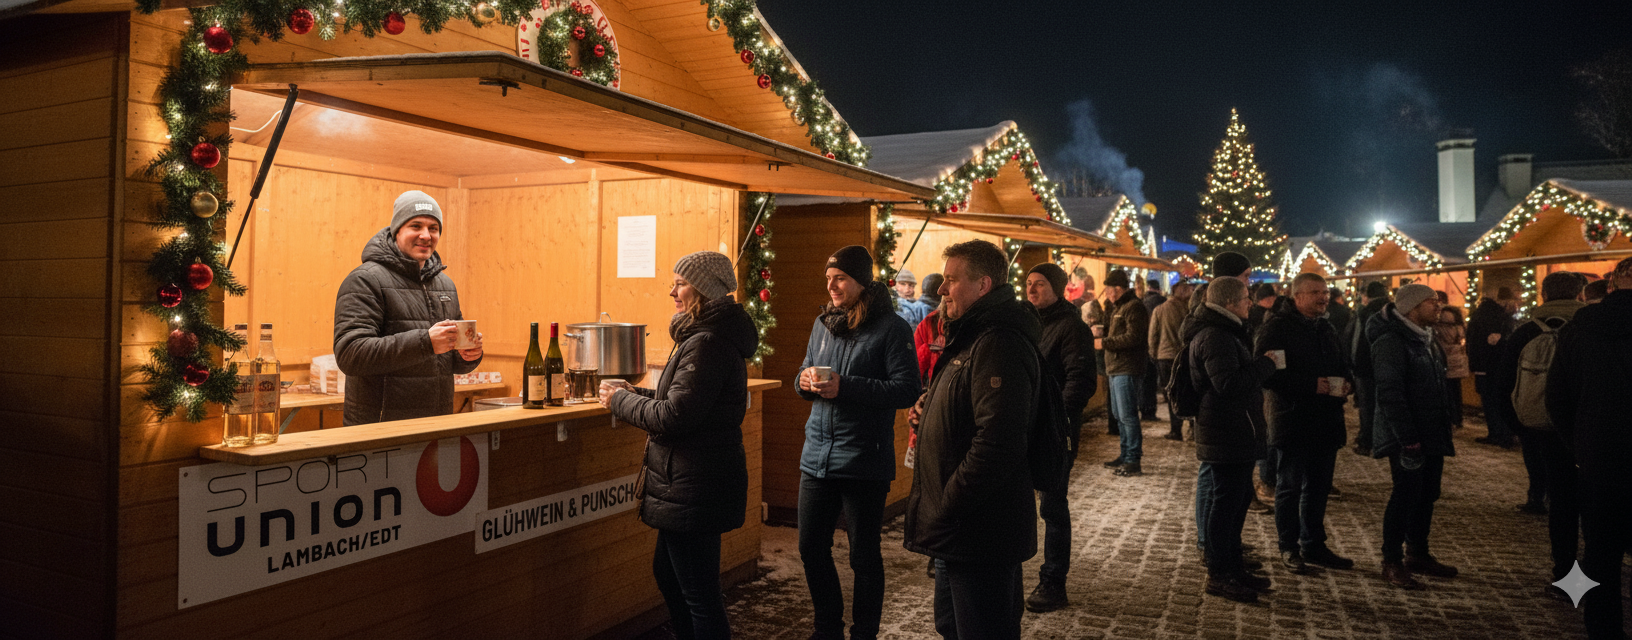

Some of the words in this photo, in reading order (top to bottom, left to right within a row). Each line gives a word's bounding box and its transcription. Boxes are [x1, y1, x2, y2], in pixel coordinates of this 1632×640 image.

[207, 448, 402, 513] SPORT
[482, 500, 564, 542] GLÜHWEIN
[568, 497, 578, 518] &
[581, 482, 635, 515] PUNSCH
[267, 524, 402, 574] LAMBACH/EDT
